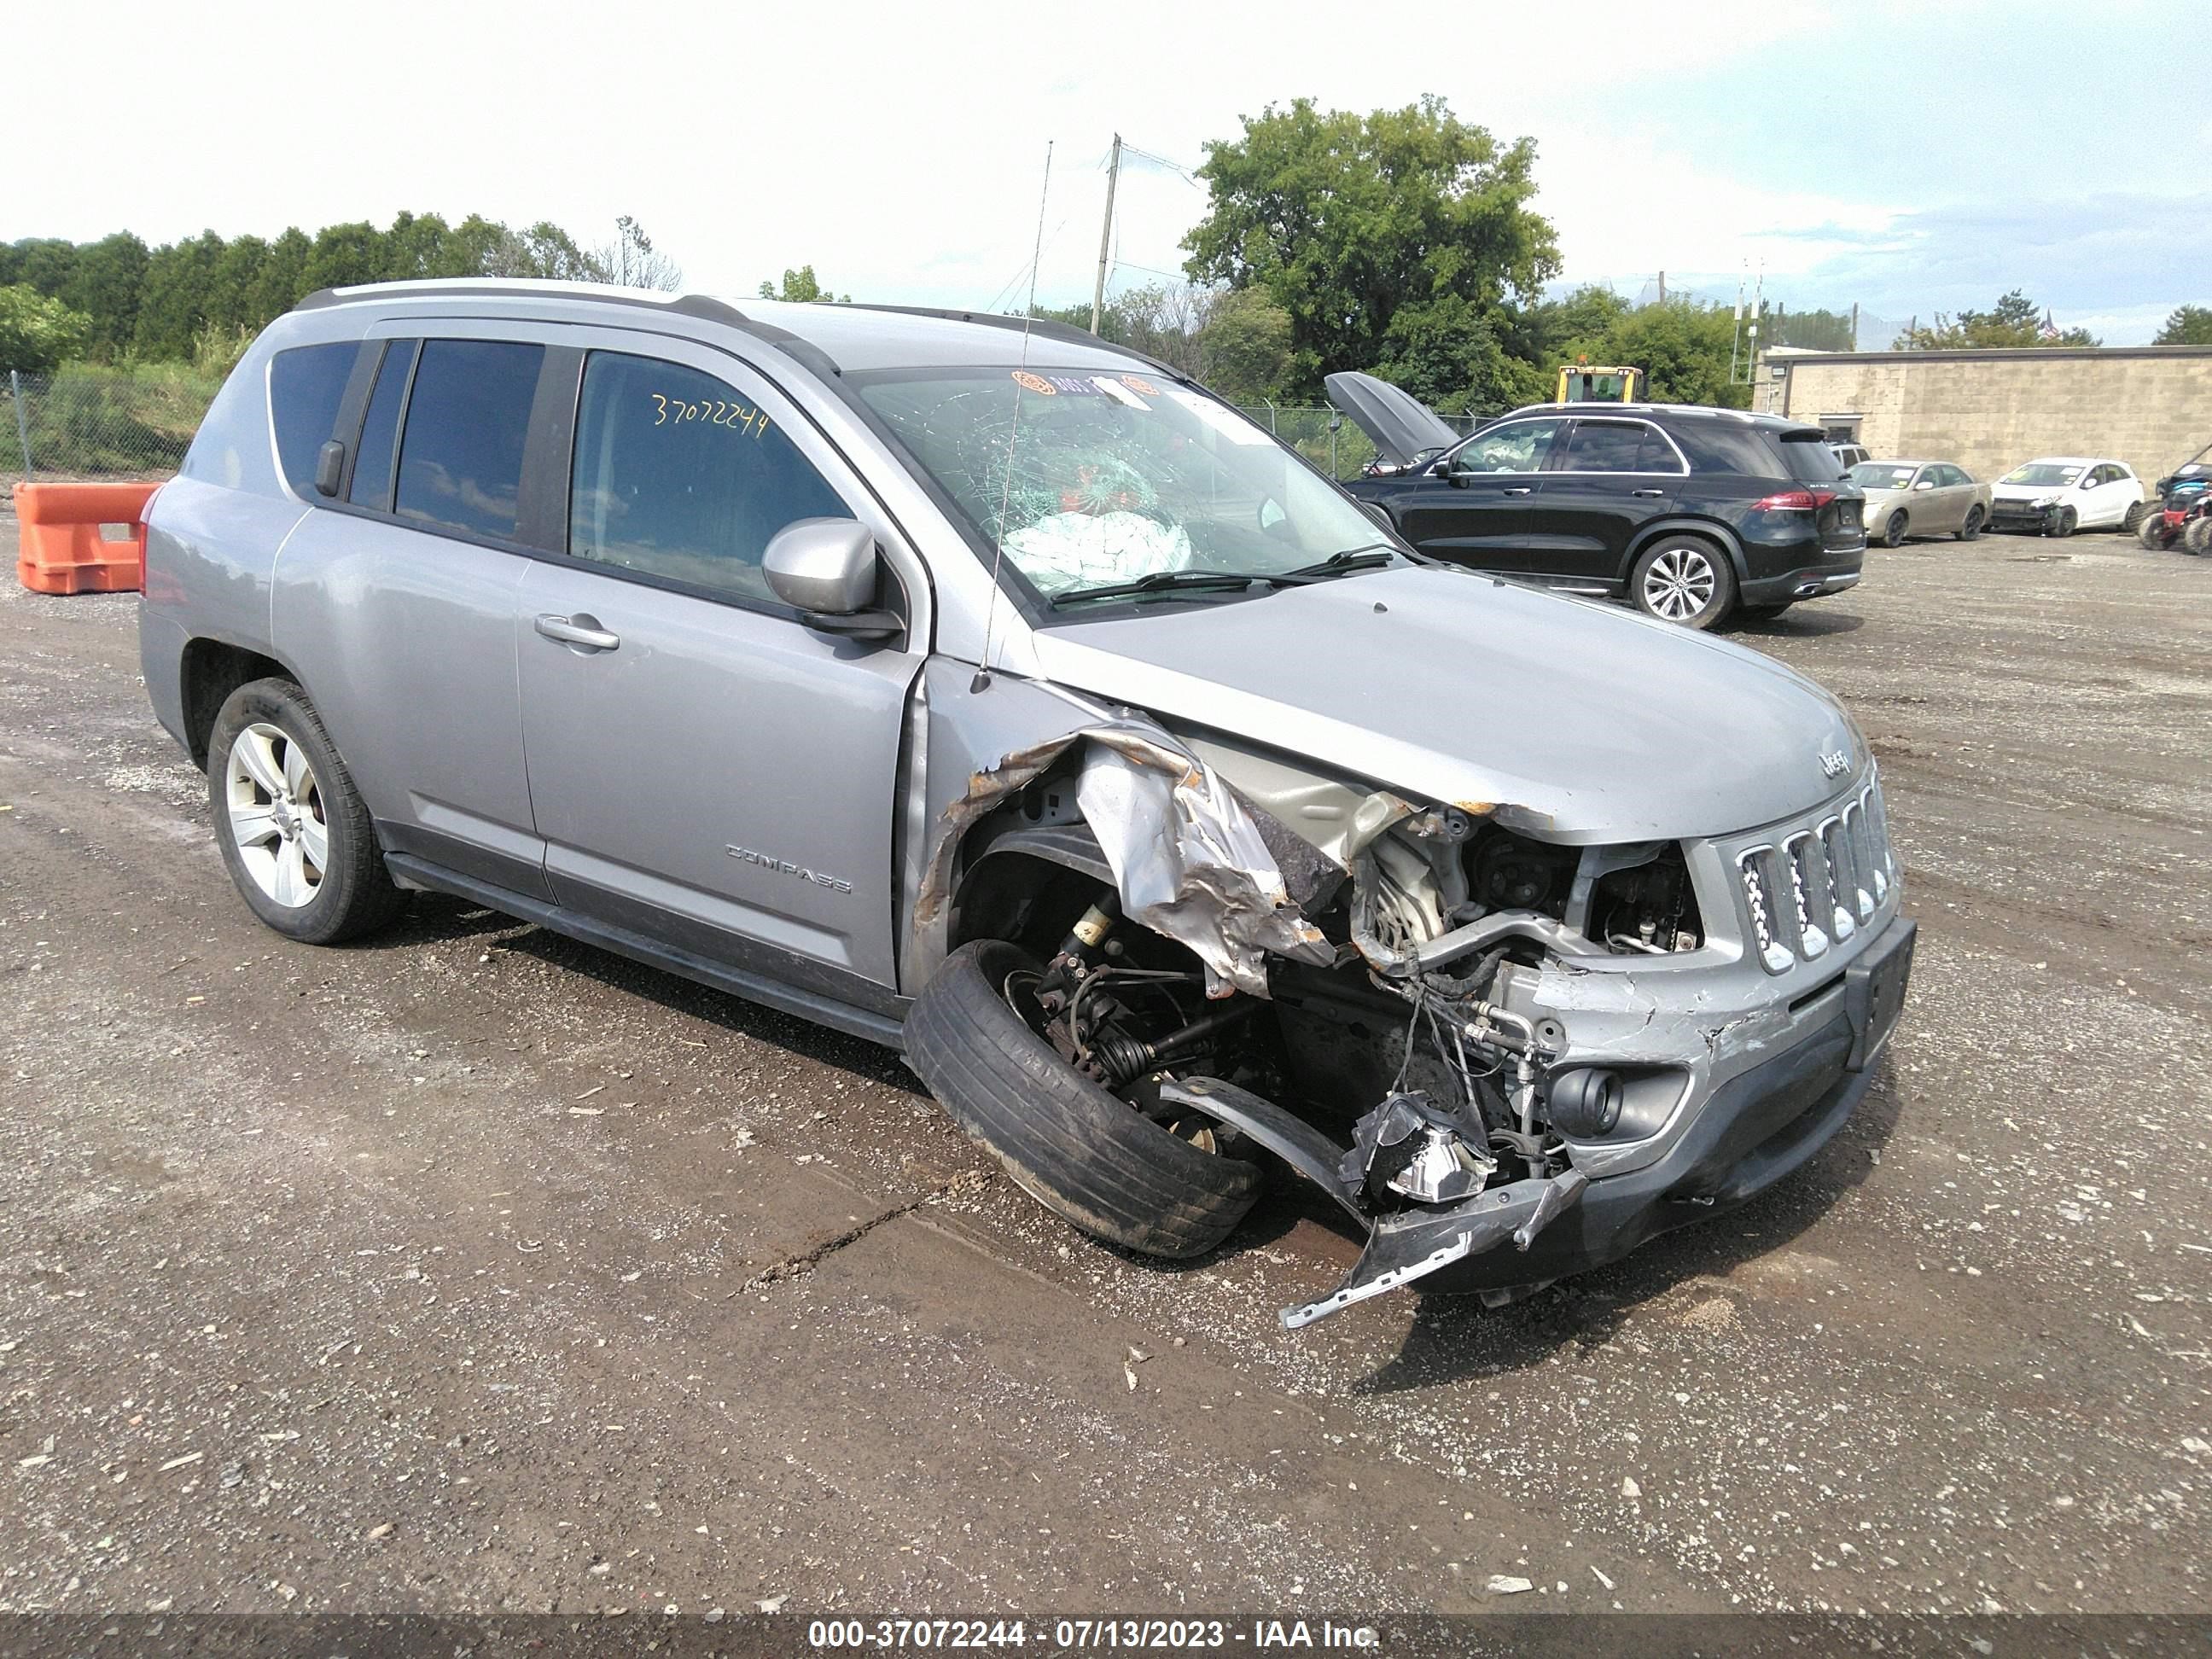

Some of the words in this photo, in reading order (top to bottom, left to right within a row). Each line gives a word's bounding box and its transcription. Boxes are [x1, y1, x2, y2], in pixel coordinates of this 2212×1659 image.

[651, 393, 770, 439] 37072244
[1819, 749, 1851, 778] Jeep
[725, 843, 852, 894] COMPASS
